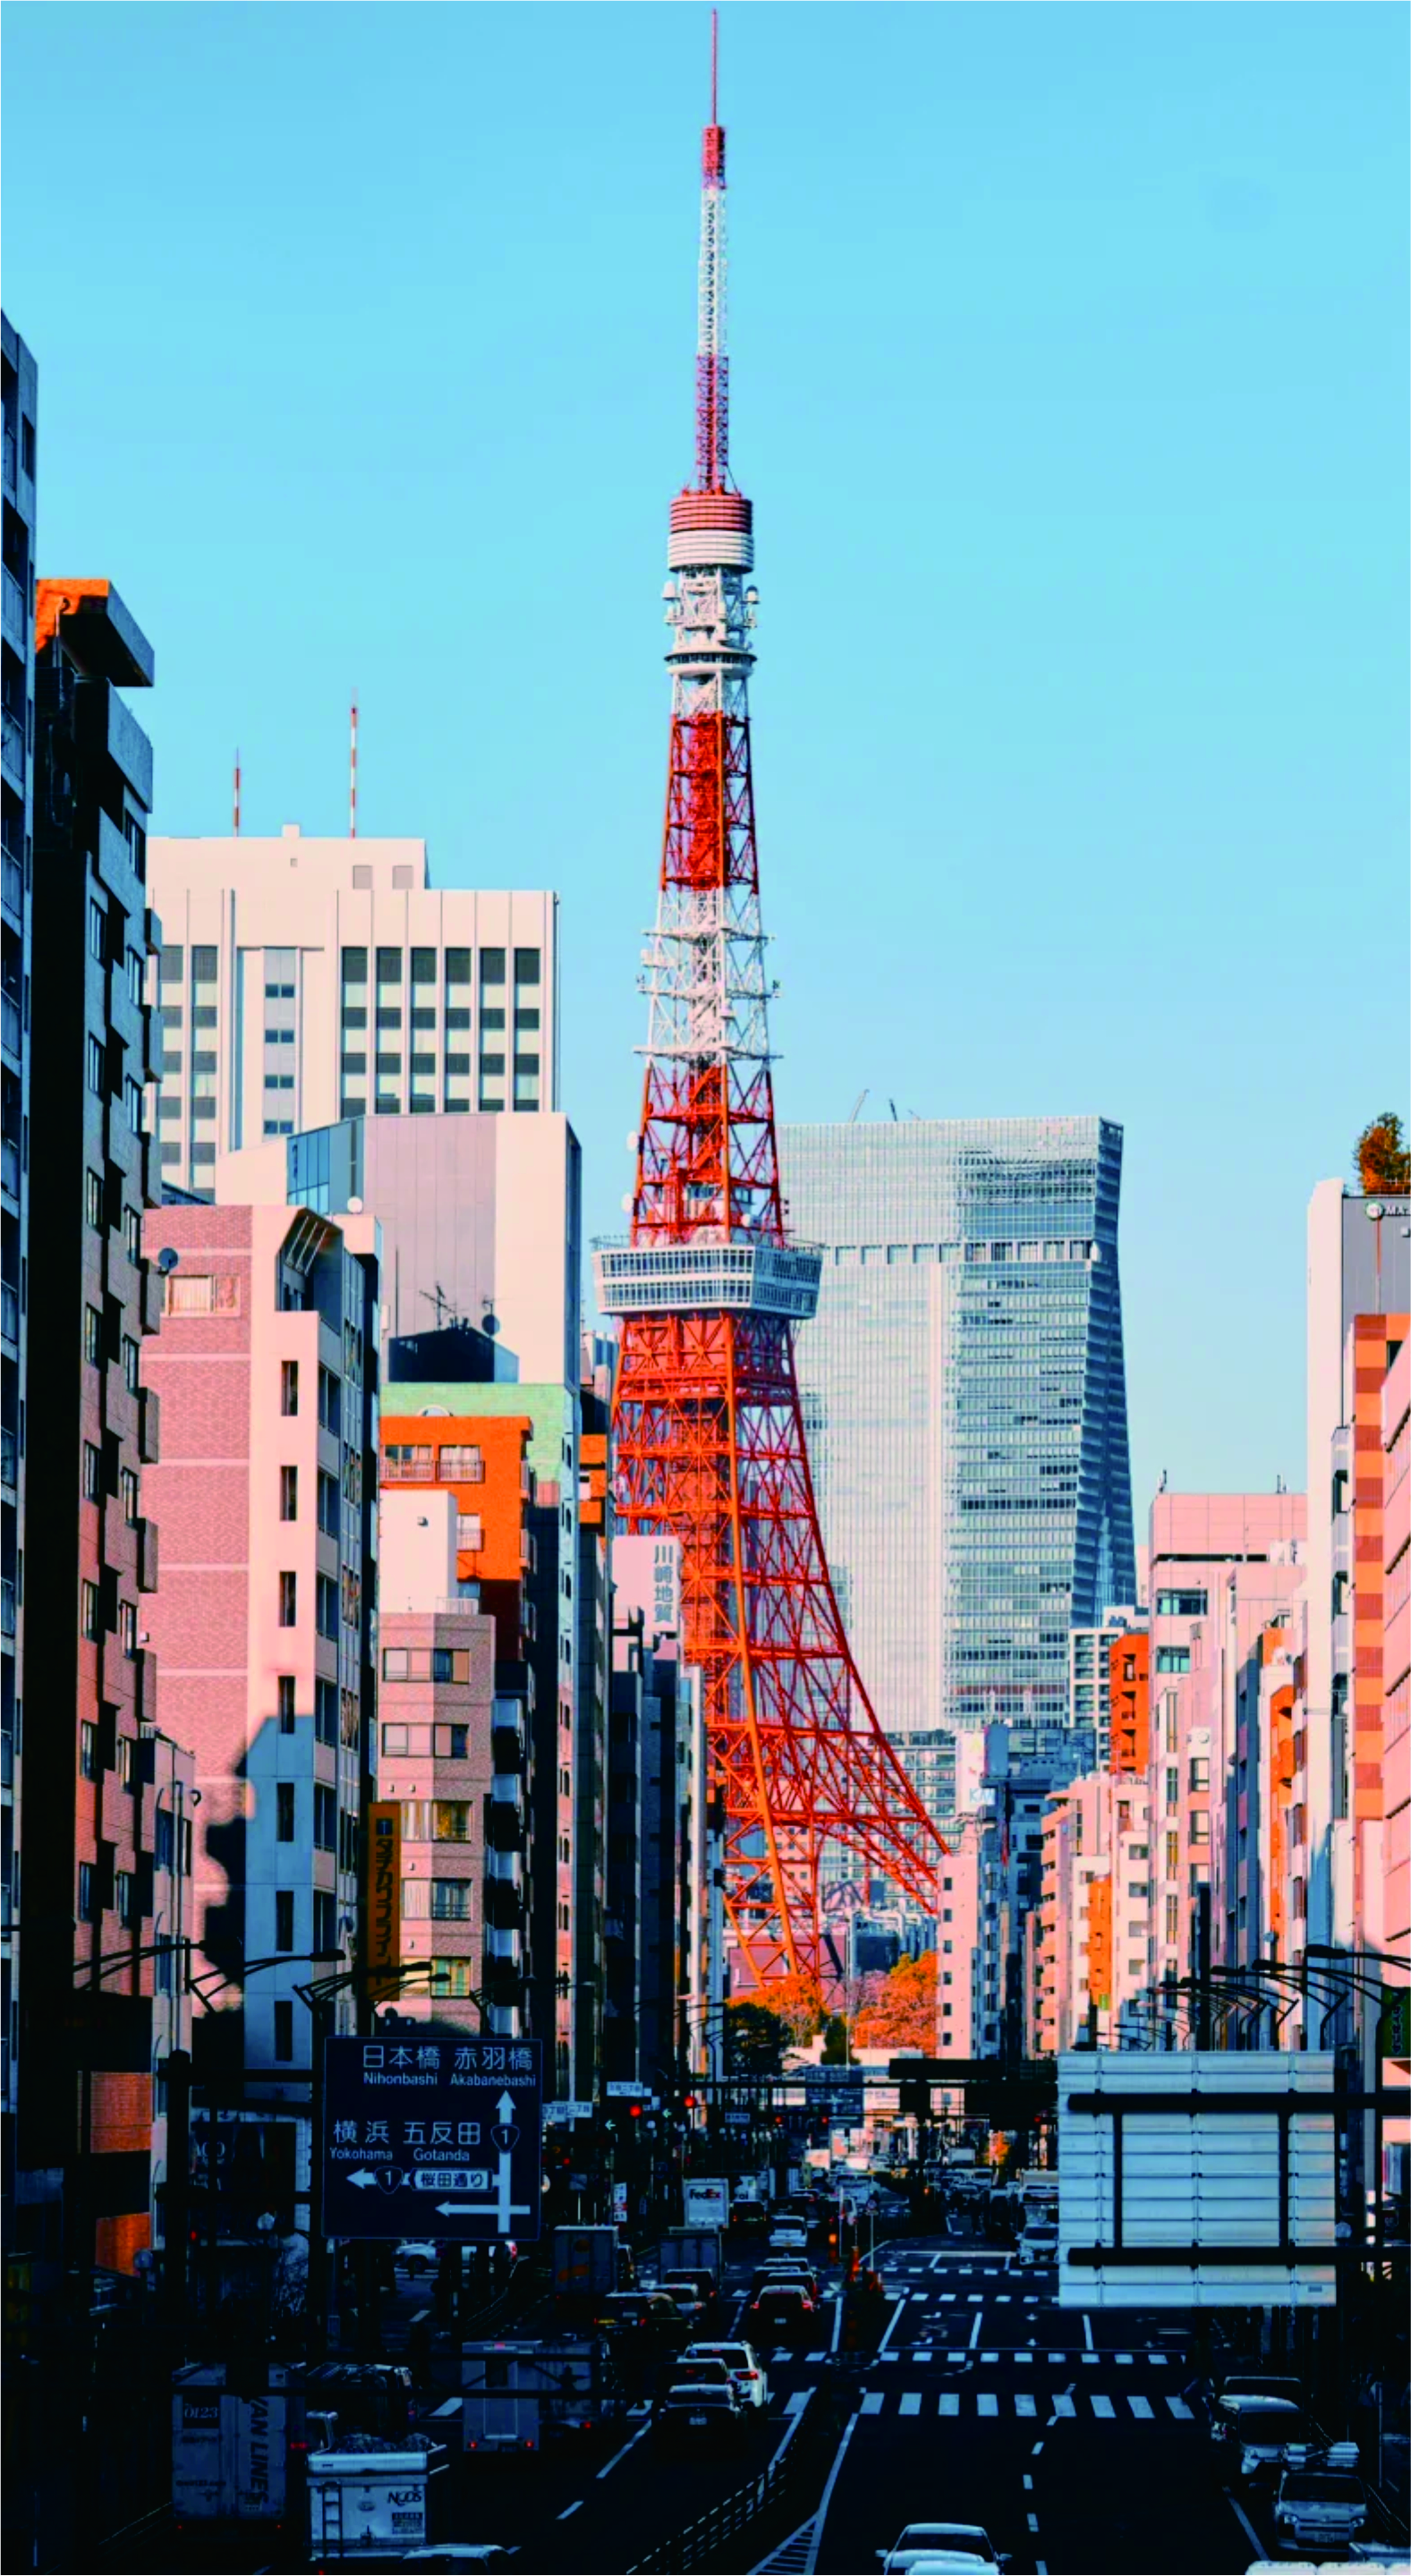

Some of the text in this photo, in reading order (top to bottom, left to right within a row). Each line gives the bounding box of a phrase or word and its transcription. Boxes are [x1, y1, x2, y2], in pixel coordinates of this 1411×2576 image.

[654, 1544, 674, 1623] 川崎地質
[362, 2045, 532, 2070] 日本橋 赤羽橋
[363, 2072, 536, 2087] Nihonbashi Akabanebashi
[333, 2120, 480, 2145] 横浜 五反田
[500, 2129, 508, 2145] 1
[329, 2147, 470, 2161] Yokohama Gotanda
[385, 2171, 392, 2186] 1
[421, 2172, 483, 2188] 桜田通り
[690, 2189, 721, 2200] FedEx
[184, 2404, 218, 2419] 0123
